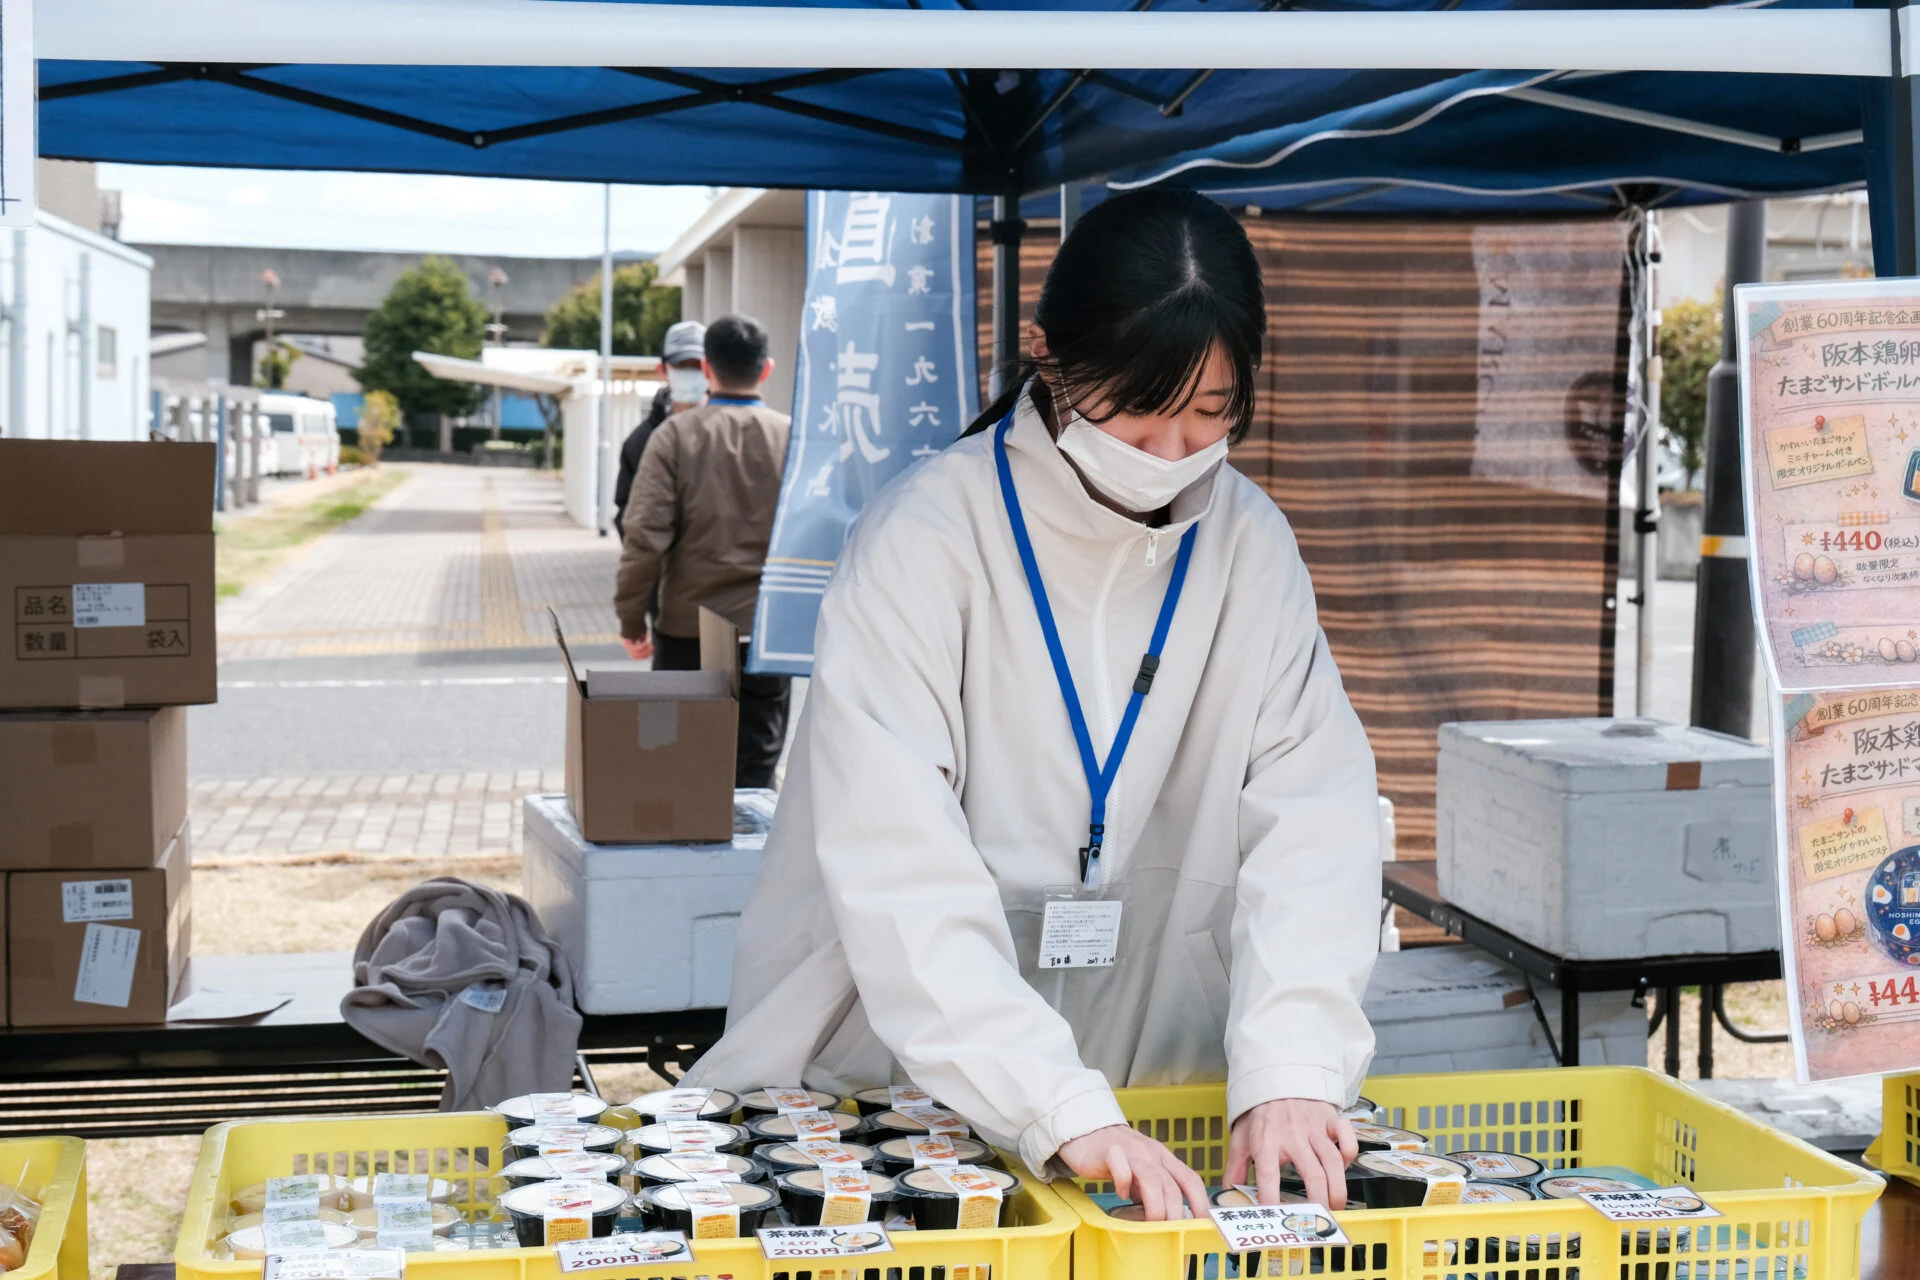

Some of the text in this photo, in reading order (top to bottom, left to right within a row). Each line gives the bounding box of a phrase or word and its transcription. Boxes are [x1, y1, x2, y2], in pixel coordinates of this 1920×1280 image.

[1781, 310, 1920, 333] 創業60周年記念企画
[1821, 340, 1920, 367] 阪本鶏卵
[24, 595, 67, 615] 品名
[24, 632, 68, 651] 数量
[1589, 1192, 1662, 1201] 茶碗蒸し
[1219, 1208, 1295, 1221] 茶碗蒸し
[766, 1228, 847, 1239] 茶碗蒸し
[1236, 1223, 1274, 1232] (穴子)
[1236, 1233, 1300, 1247] 200円
[774, 1247, 840, 1256] 200円
[572, 1254, 639, 1269] 200円
